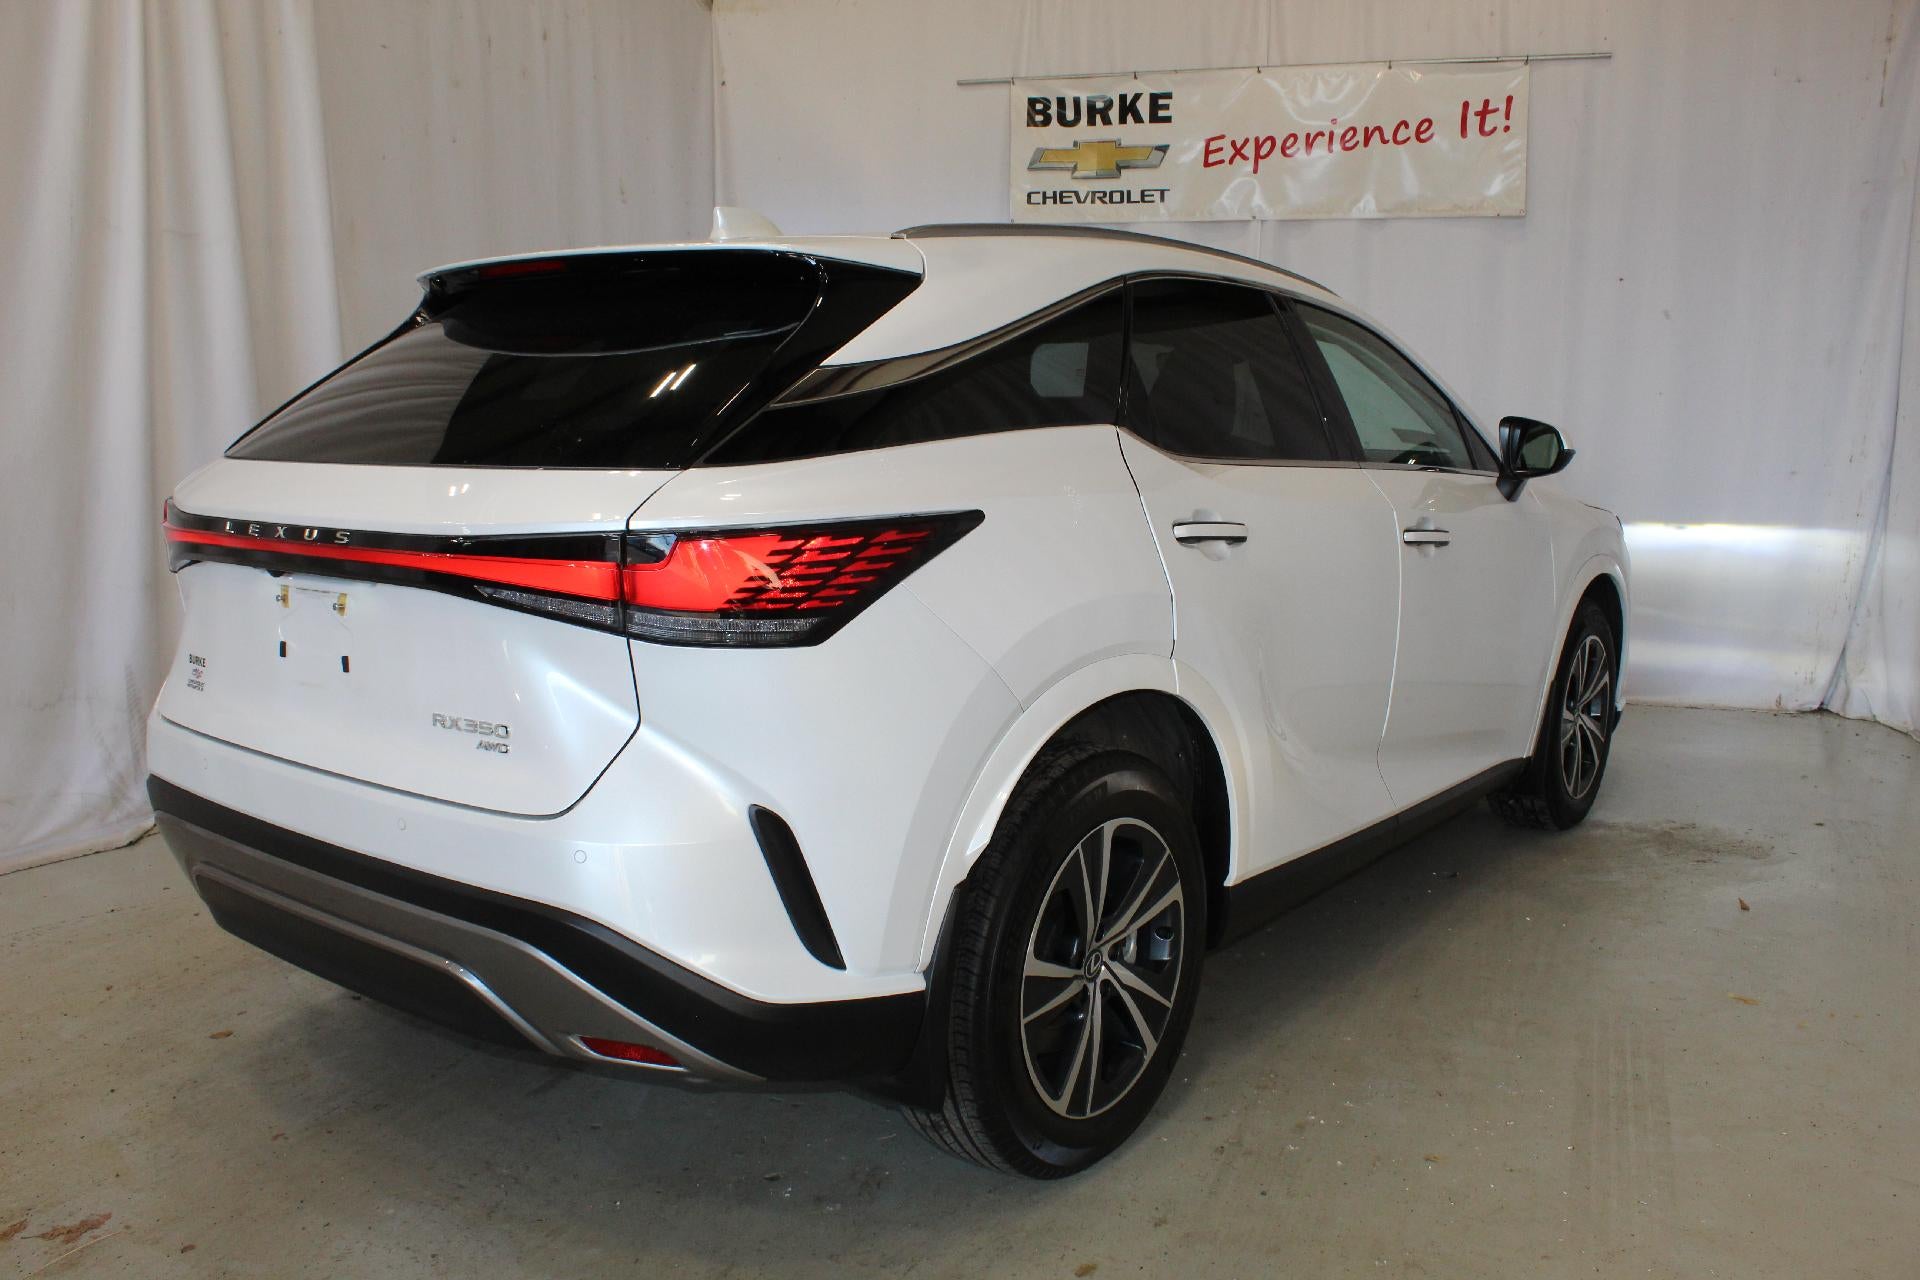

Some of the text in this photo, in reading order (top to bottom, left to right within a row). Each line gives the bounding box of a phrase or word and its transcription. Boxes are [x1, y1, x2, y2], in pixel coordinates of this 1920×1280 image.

[1026, 92, 1173, 127] BURKE
[1202, 95, 1514, 174] Experience It!
[1026, 189, 1170, 205] CHEVROLET
[224, 521, 350, 544] LEXUS
[189, 653, 206, 668] BURKE
[476, 740, 510, 754] AWD
